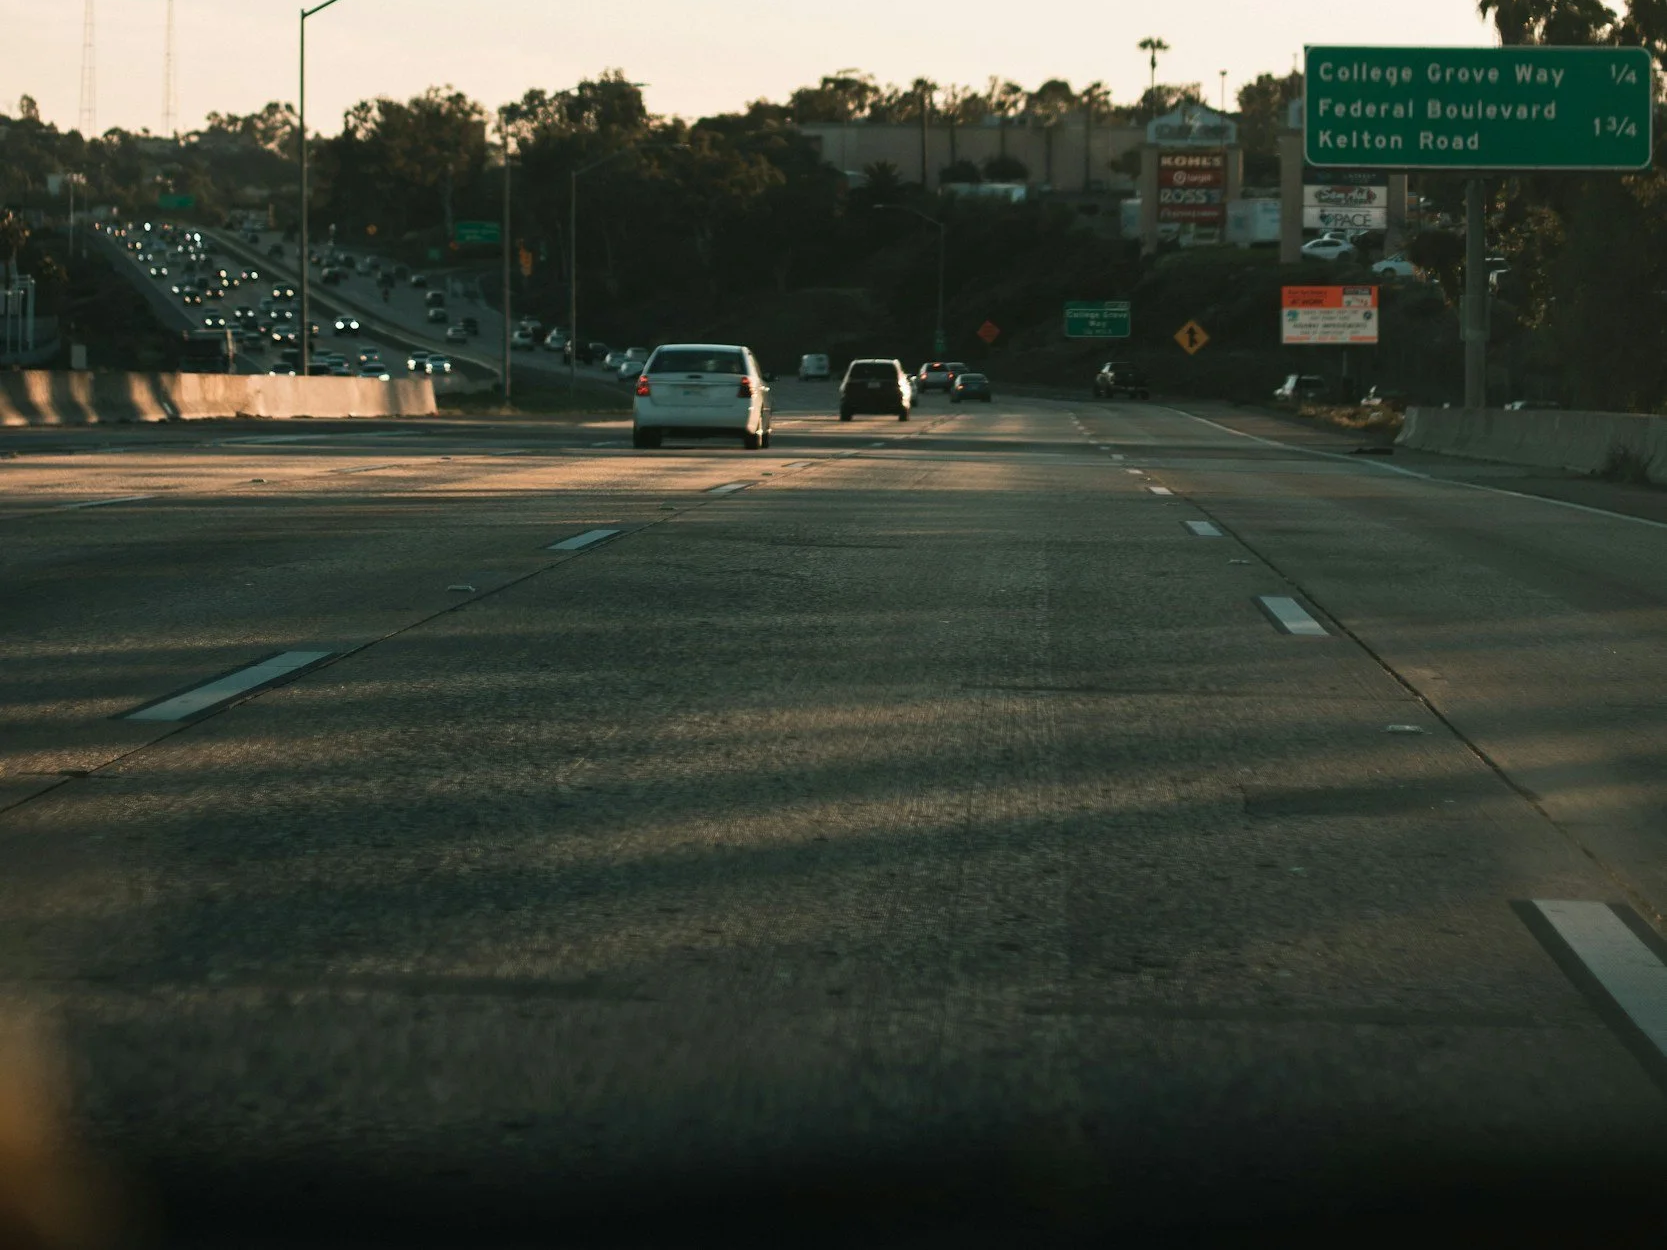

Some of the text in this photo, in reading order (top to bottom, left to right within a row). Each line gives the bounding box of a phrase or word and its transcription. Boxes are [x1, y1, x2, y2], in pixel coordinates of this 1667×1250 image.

[1319, 62, 1413, 87] College
[1427, 62, 1499, 83] Grove
[1515, 63, 1564, 88] Way
[1319, 98, 1556, 119] Federal Boulevard
[1319, 130, 1480, 150] Kelton Road
[1161, 155, 1221, 167] KOHL'S
[1160, 188, 1207, 204] ROSS
[1334, 213, 1372, 227] PACE
